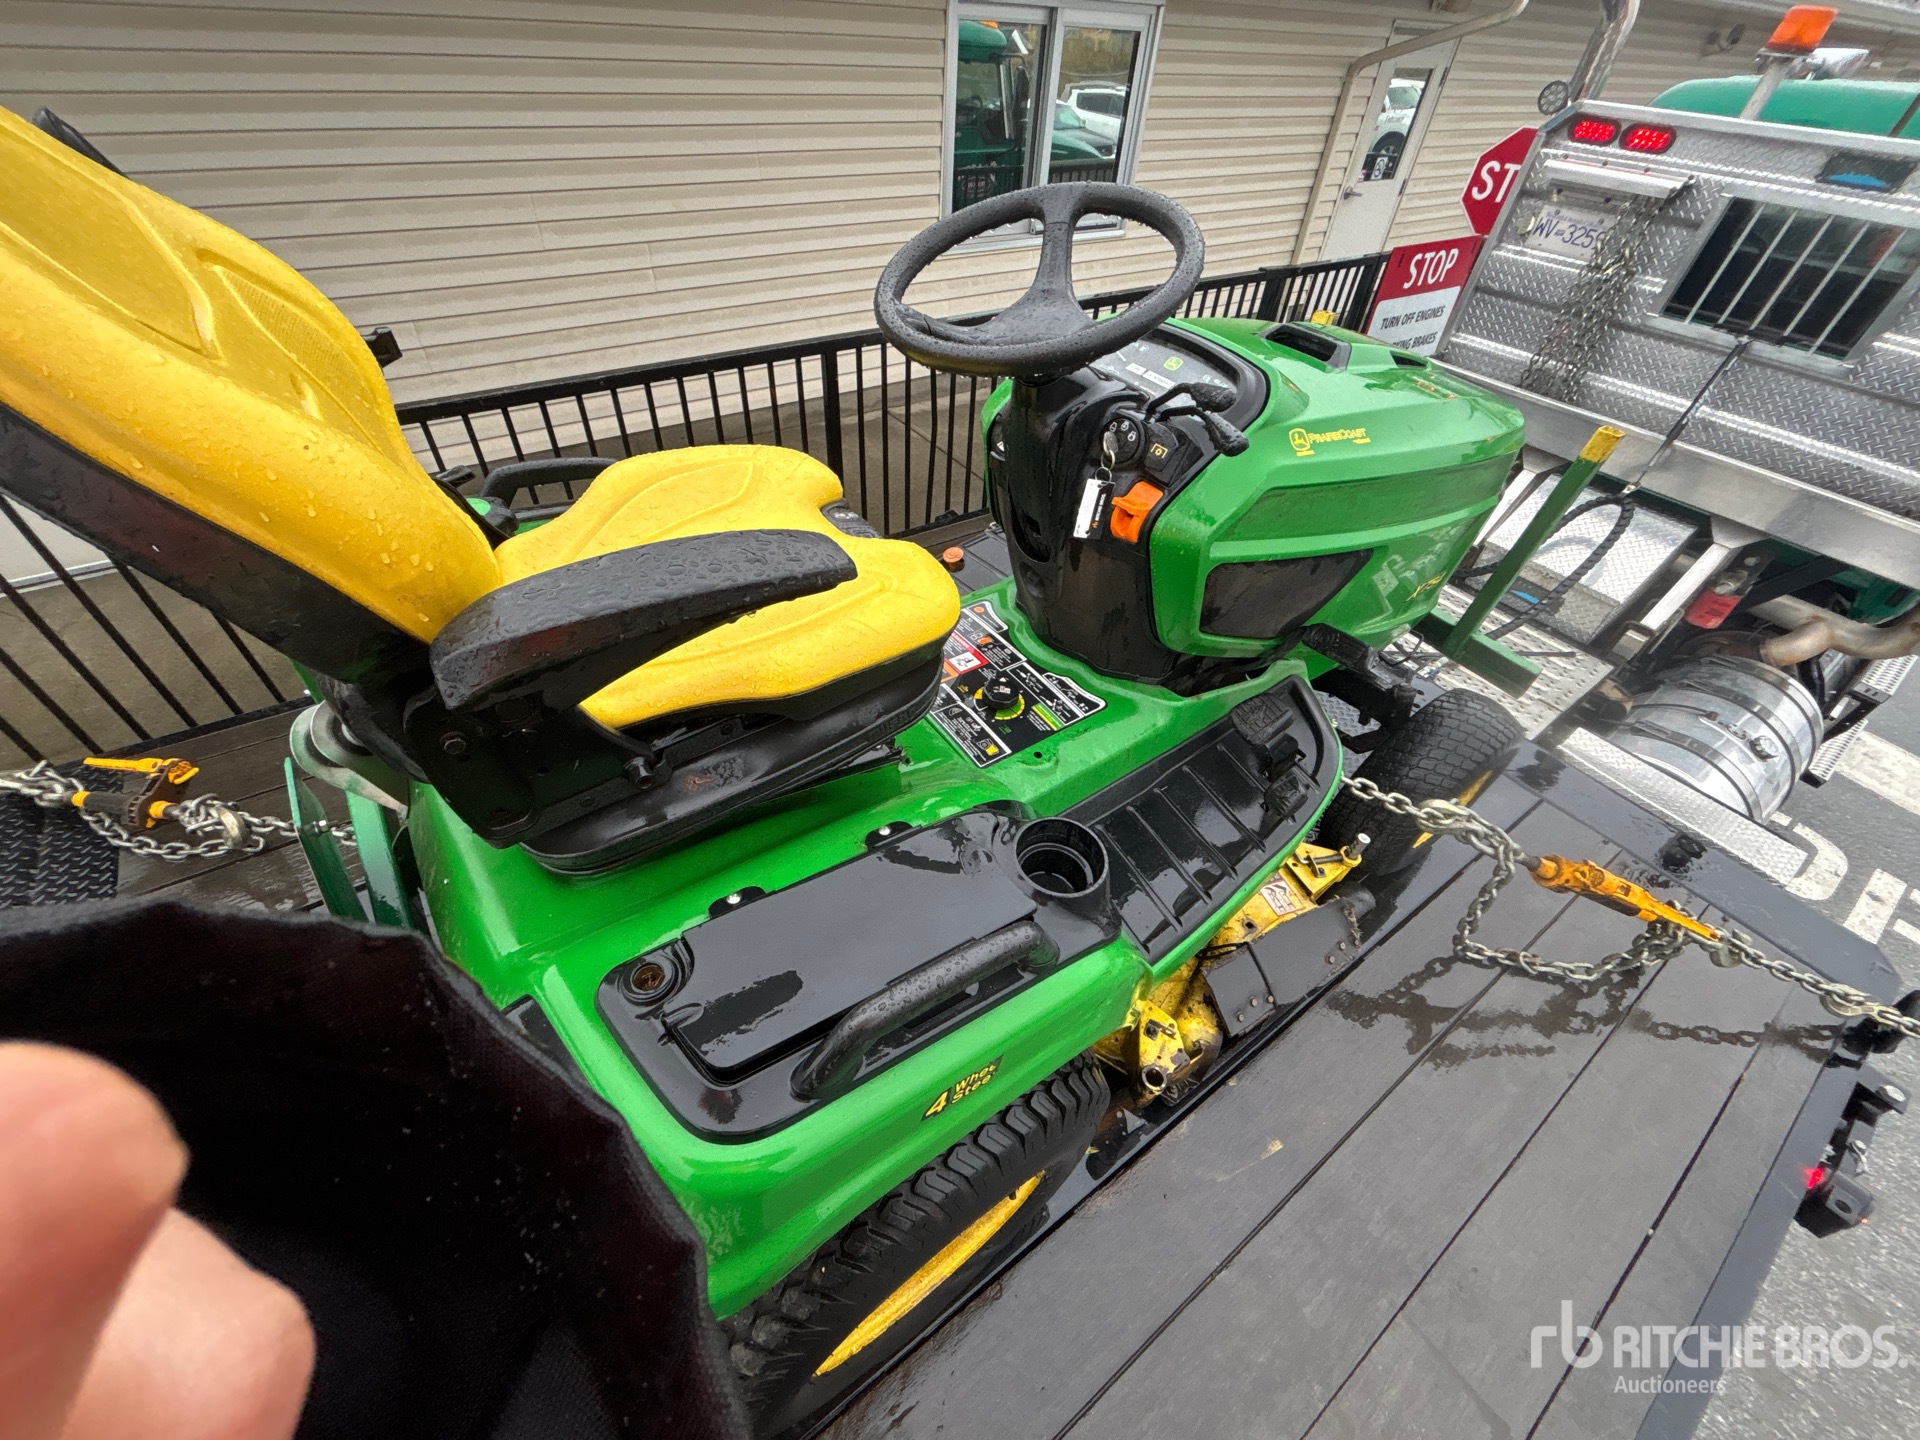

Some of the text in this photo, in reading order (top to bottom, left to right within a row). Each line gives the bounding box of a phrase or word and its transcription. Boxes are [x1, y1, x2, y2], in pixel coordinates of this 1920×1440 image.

[1471, 160, 1522, 203] ST
[1403, 248, 1459, 289] STOP
[1380, 305, 1445, 330] TURN OFF ENGINES
[1411, 331, 1438, 349] BRAKES
[925, 1091, 949, 1117] 4
